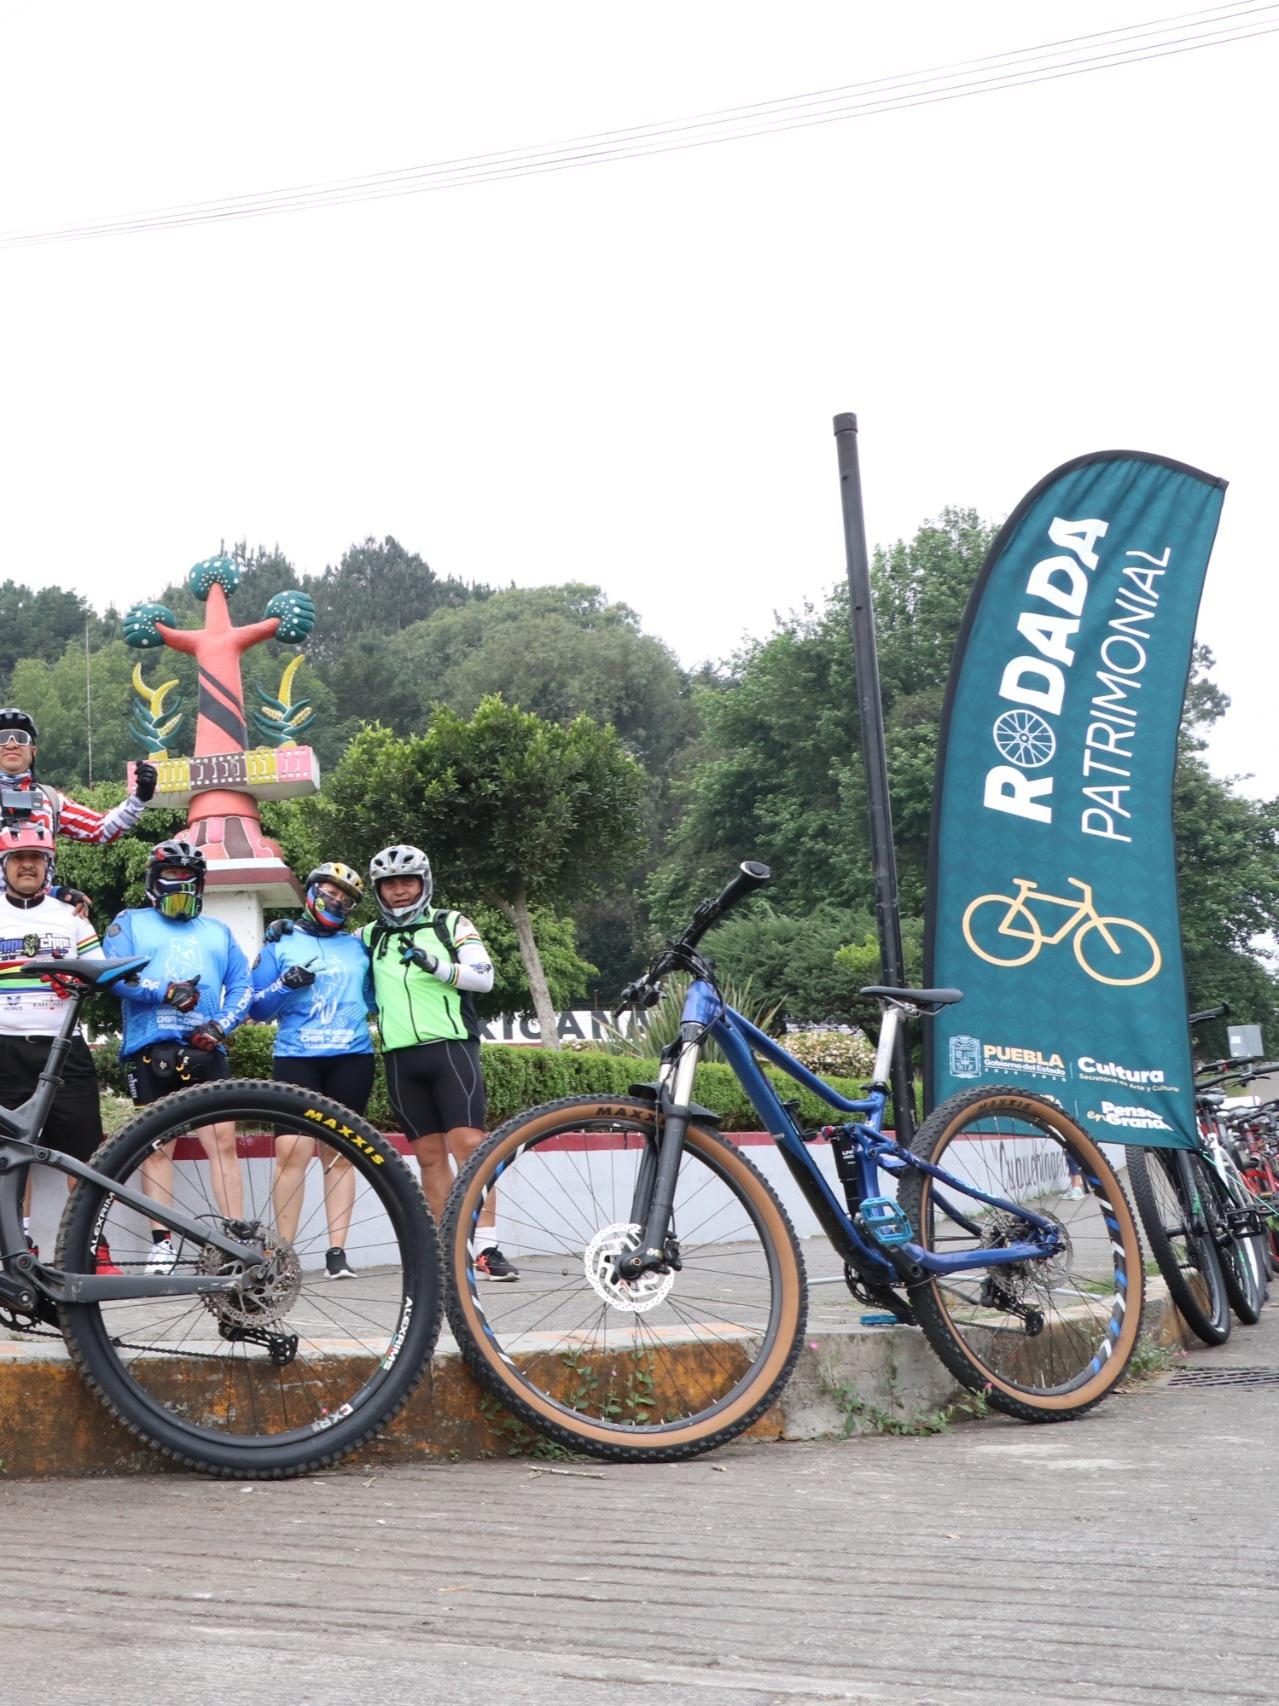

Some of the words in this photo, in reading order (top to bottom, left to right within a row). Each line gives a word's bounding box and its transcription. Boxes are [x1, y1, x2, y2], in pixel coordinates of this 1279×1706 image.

[1081, 547, 1171, 843] PATRIMONIAL
[983, 1044, 1065, 1069] PUEBLA
[984, 1059, 1022, 1070] Gobierno
[1023, 1063, 1035, 1071] del
[1037, 1065, 1066, 1076] Estado
[1078, 1057, 1164, 1083] Cultura
[1129, 1083, 1145, 1091] Arte
[304, 1109, 385, 1165] MAXXIS
[383, 1296, 413, 1371] ALEXRIMS
